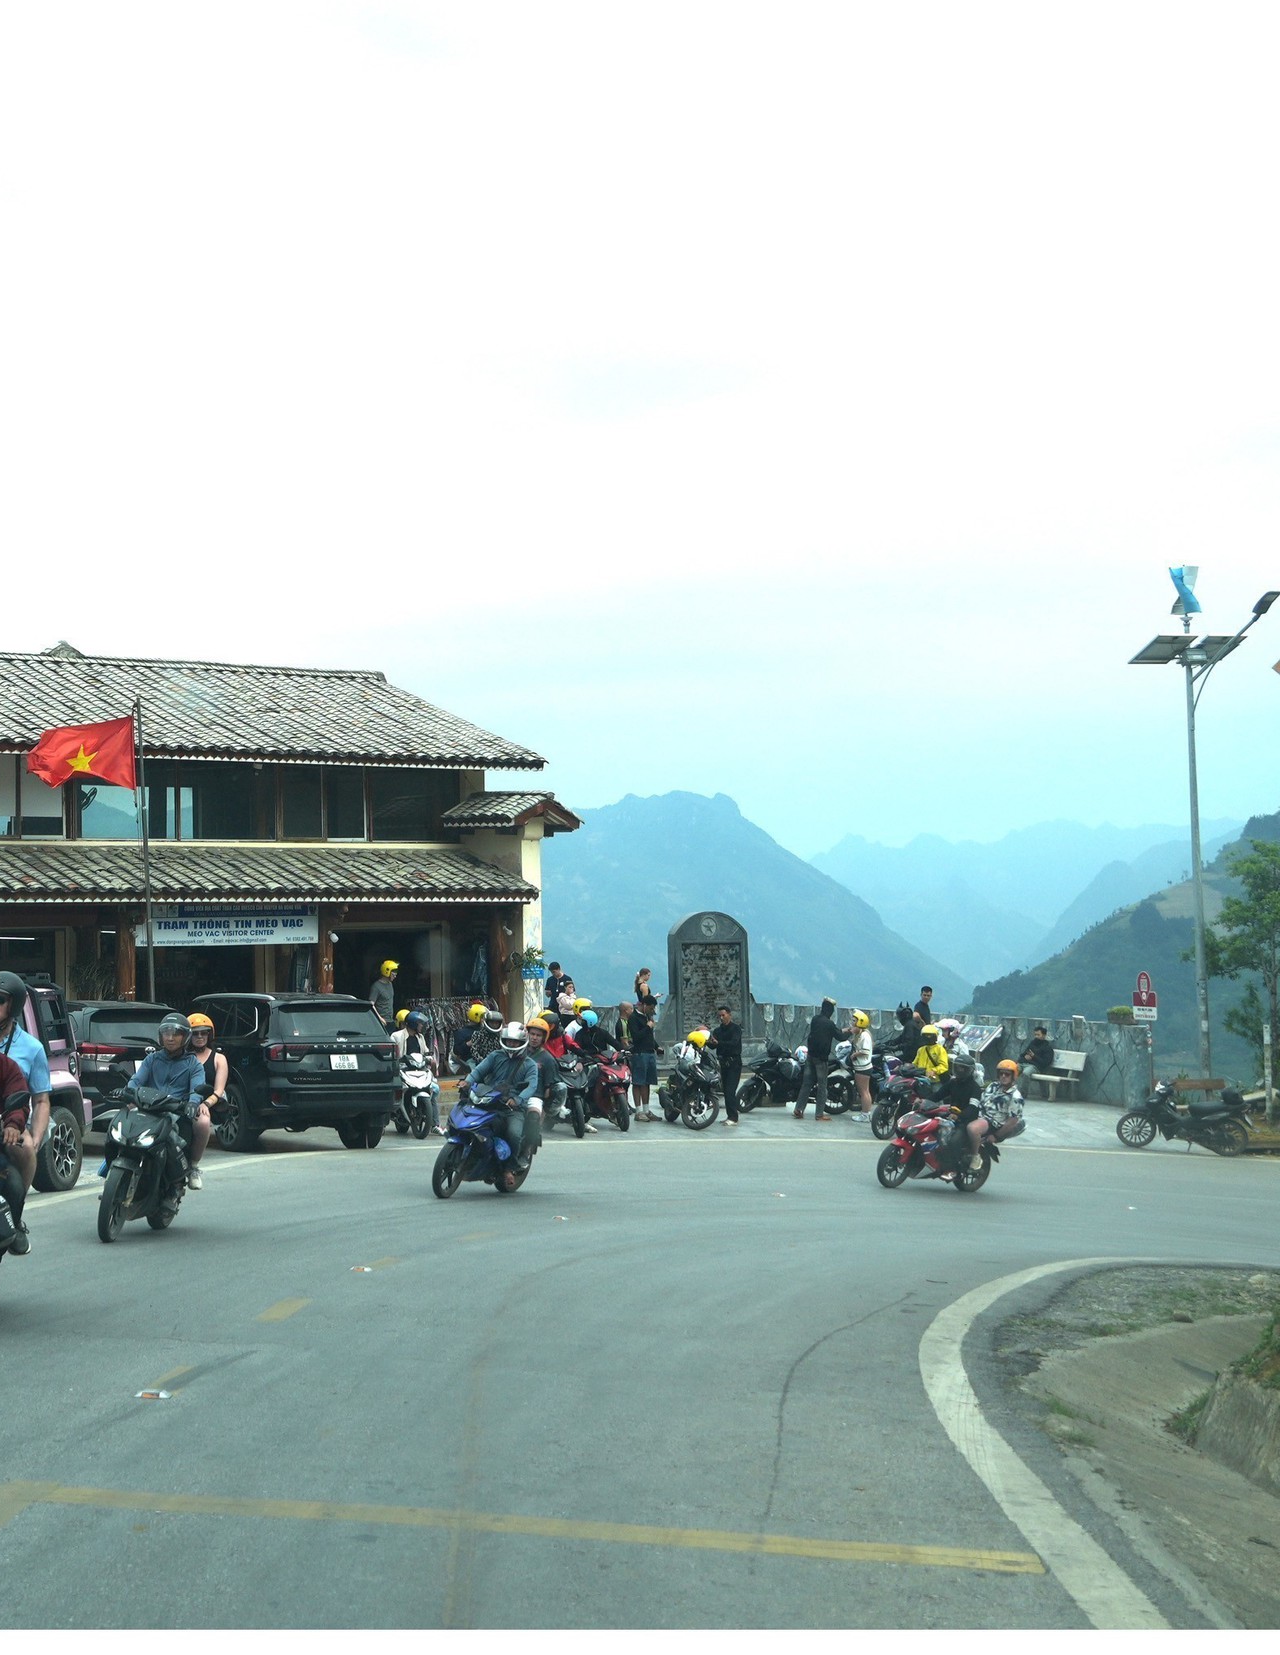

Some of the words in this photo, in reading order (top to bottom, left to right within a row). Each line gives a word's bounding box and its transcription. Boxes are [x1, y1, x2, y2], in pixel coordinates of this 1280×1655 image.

[156, 921, 188, 931] TRẠM
[192, 919, 230, 930] THÔNG
[234, 920, 252, 928] TIN
